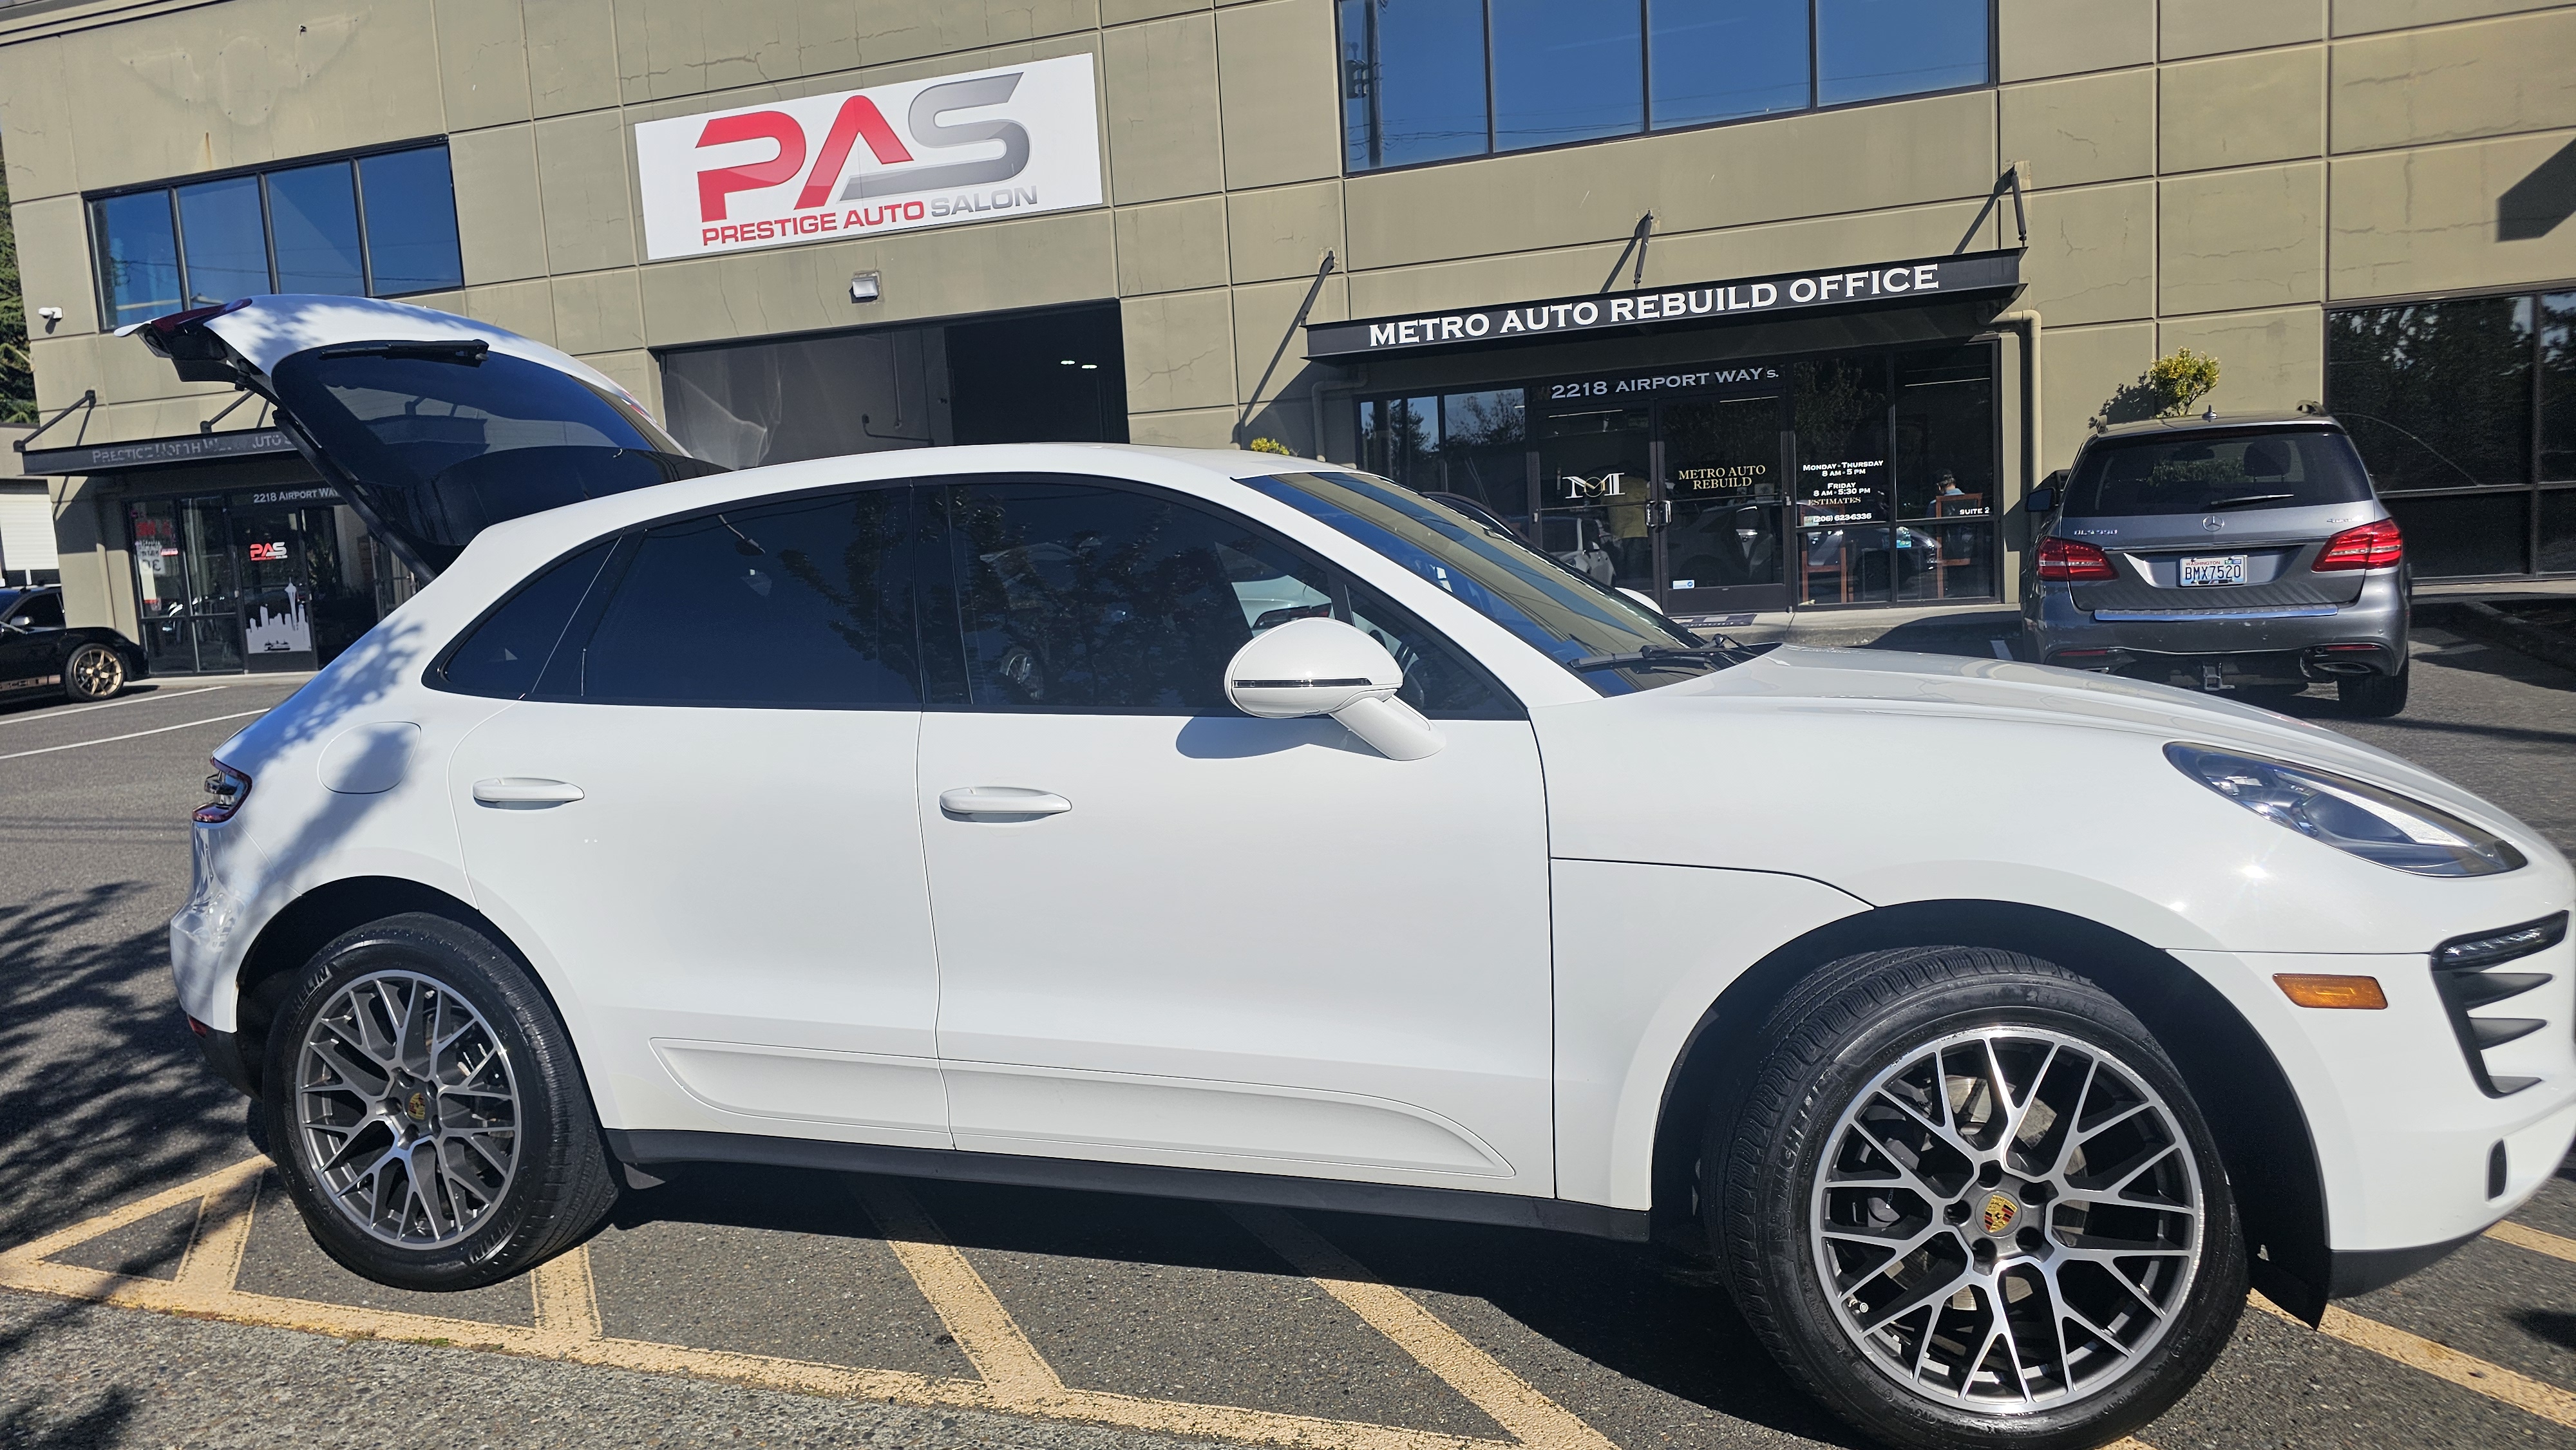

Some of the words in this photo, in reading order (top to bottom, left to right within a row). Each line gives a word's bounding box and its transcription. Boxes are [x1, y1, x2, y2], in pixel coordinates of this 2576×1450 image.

[695, 72, 1032, 223] PAS
[702, 213, 837, 247] PRESTIGE
[843, 201, 925, 229] AUTO
[931, 185, 1038, 218] SALON
[1370, 314, 1490, 348] METRO
[1499, 302, 1598, 334] AUTO
[1610, 283, 1778, 323] REBUILD
[1789, 264, 1940, 303] OFFICE
[1551, 381, 1608, 399] 2218
[1615, 372, 1710, 393] AIRPORT
[1714, 368, 1764, 383] WAY
[1841, 460, 1884, 469] THURSDAY
[1678, 467, 1725, 480] METRO
[1728, 465, 1766, 476] AUTO
[1692, 476, 1752, 490] REBUILD
[254, 492, 277, 504] 2218
[279, 489, 317, 502] AIRPORT
[1808, 496, 1861, 506] ESTIMATES
[1813, 514, 1833, 523] (206)
[250, 541, 287, 558] PAS
[2185, 565, 2241, 580] BMX7520
